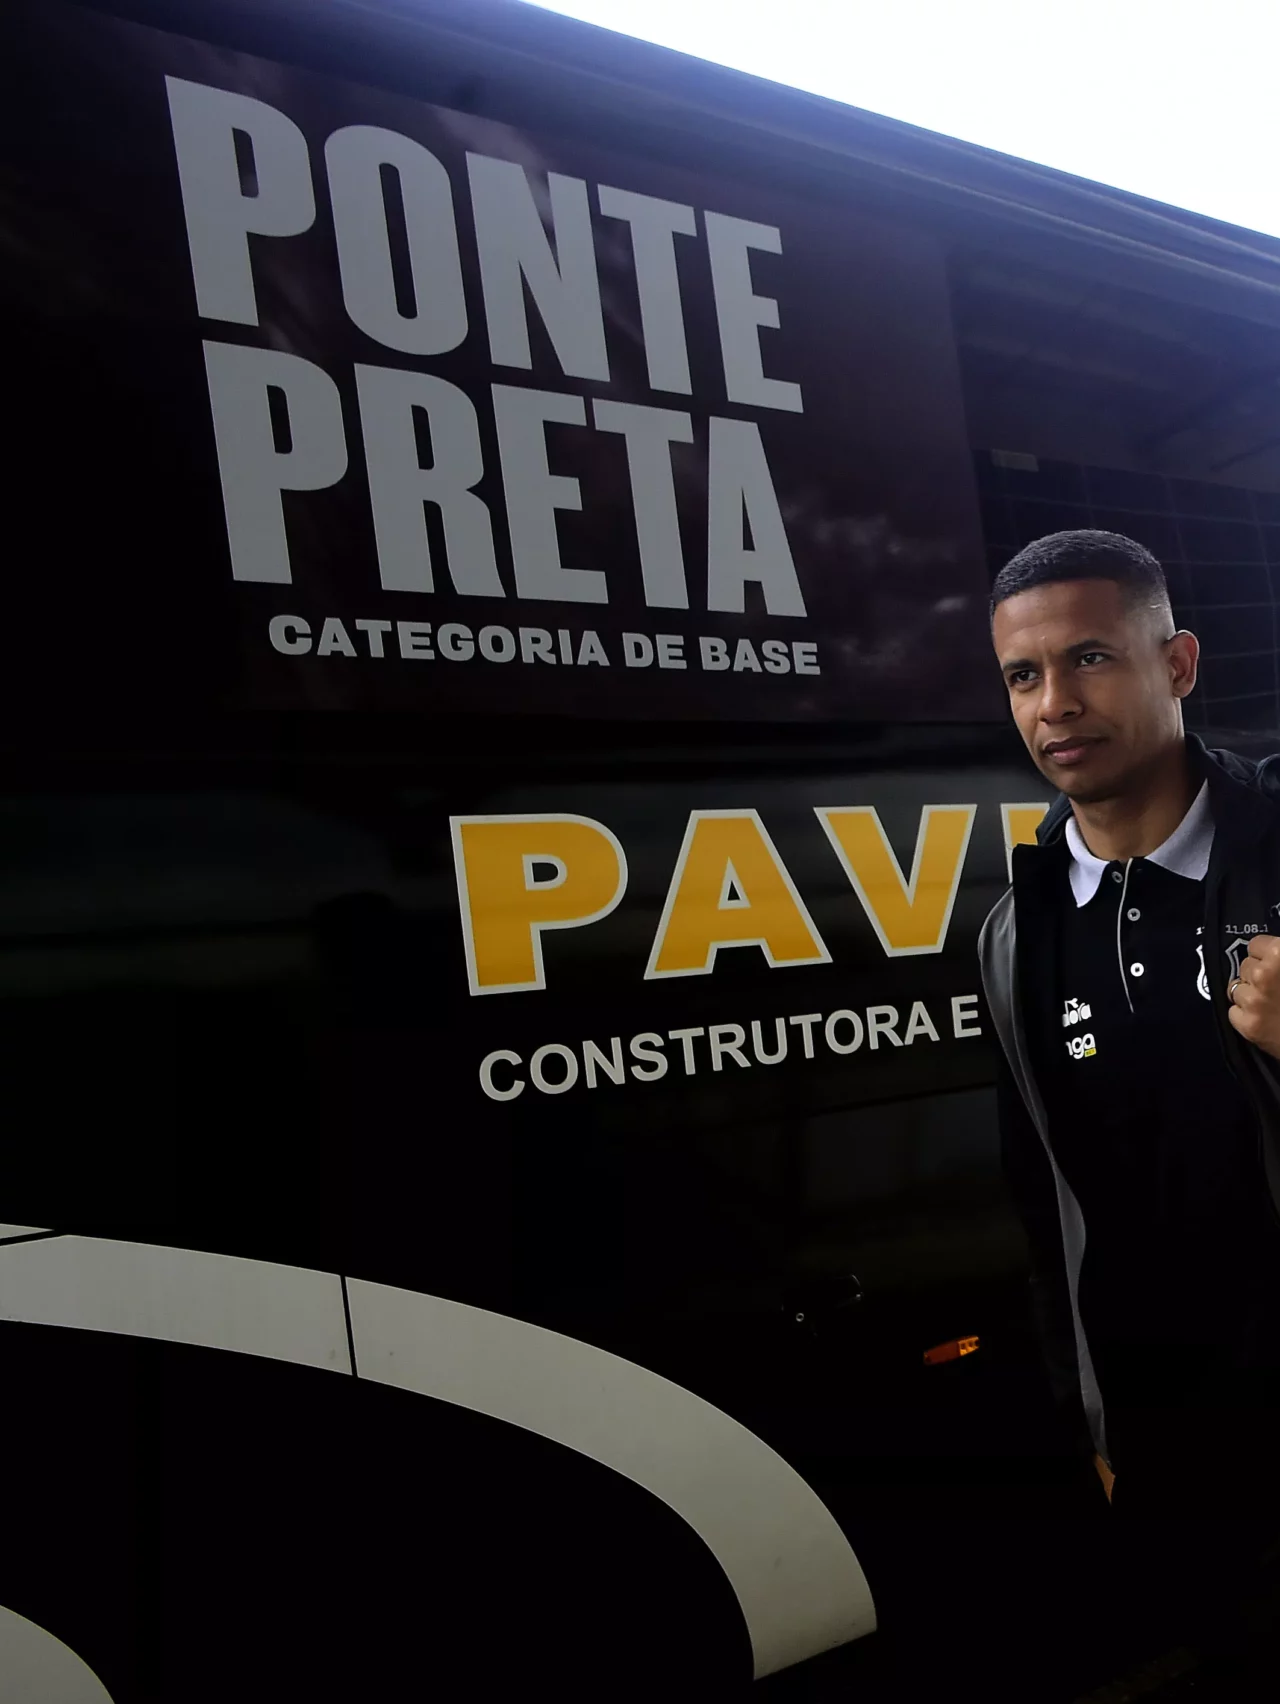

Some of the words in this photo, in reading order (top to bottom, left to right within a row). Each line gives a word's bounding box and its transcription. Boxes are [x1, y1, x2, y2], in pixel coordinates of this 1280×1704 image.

[165, 75, 803, 413] PONTE
[202, 339, 807, 617] PRETA
[268, 614, 610, 667] CATEGORIA
[622, 632, 687, 670] DE
[699, 636, 821, 676] BASE
[478, 1000, 939, 1101] CONSTRUTORA
[951, 994, 982, 1037] E
